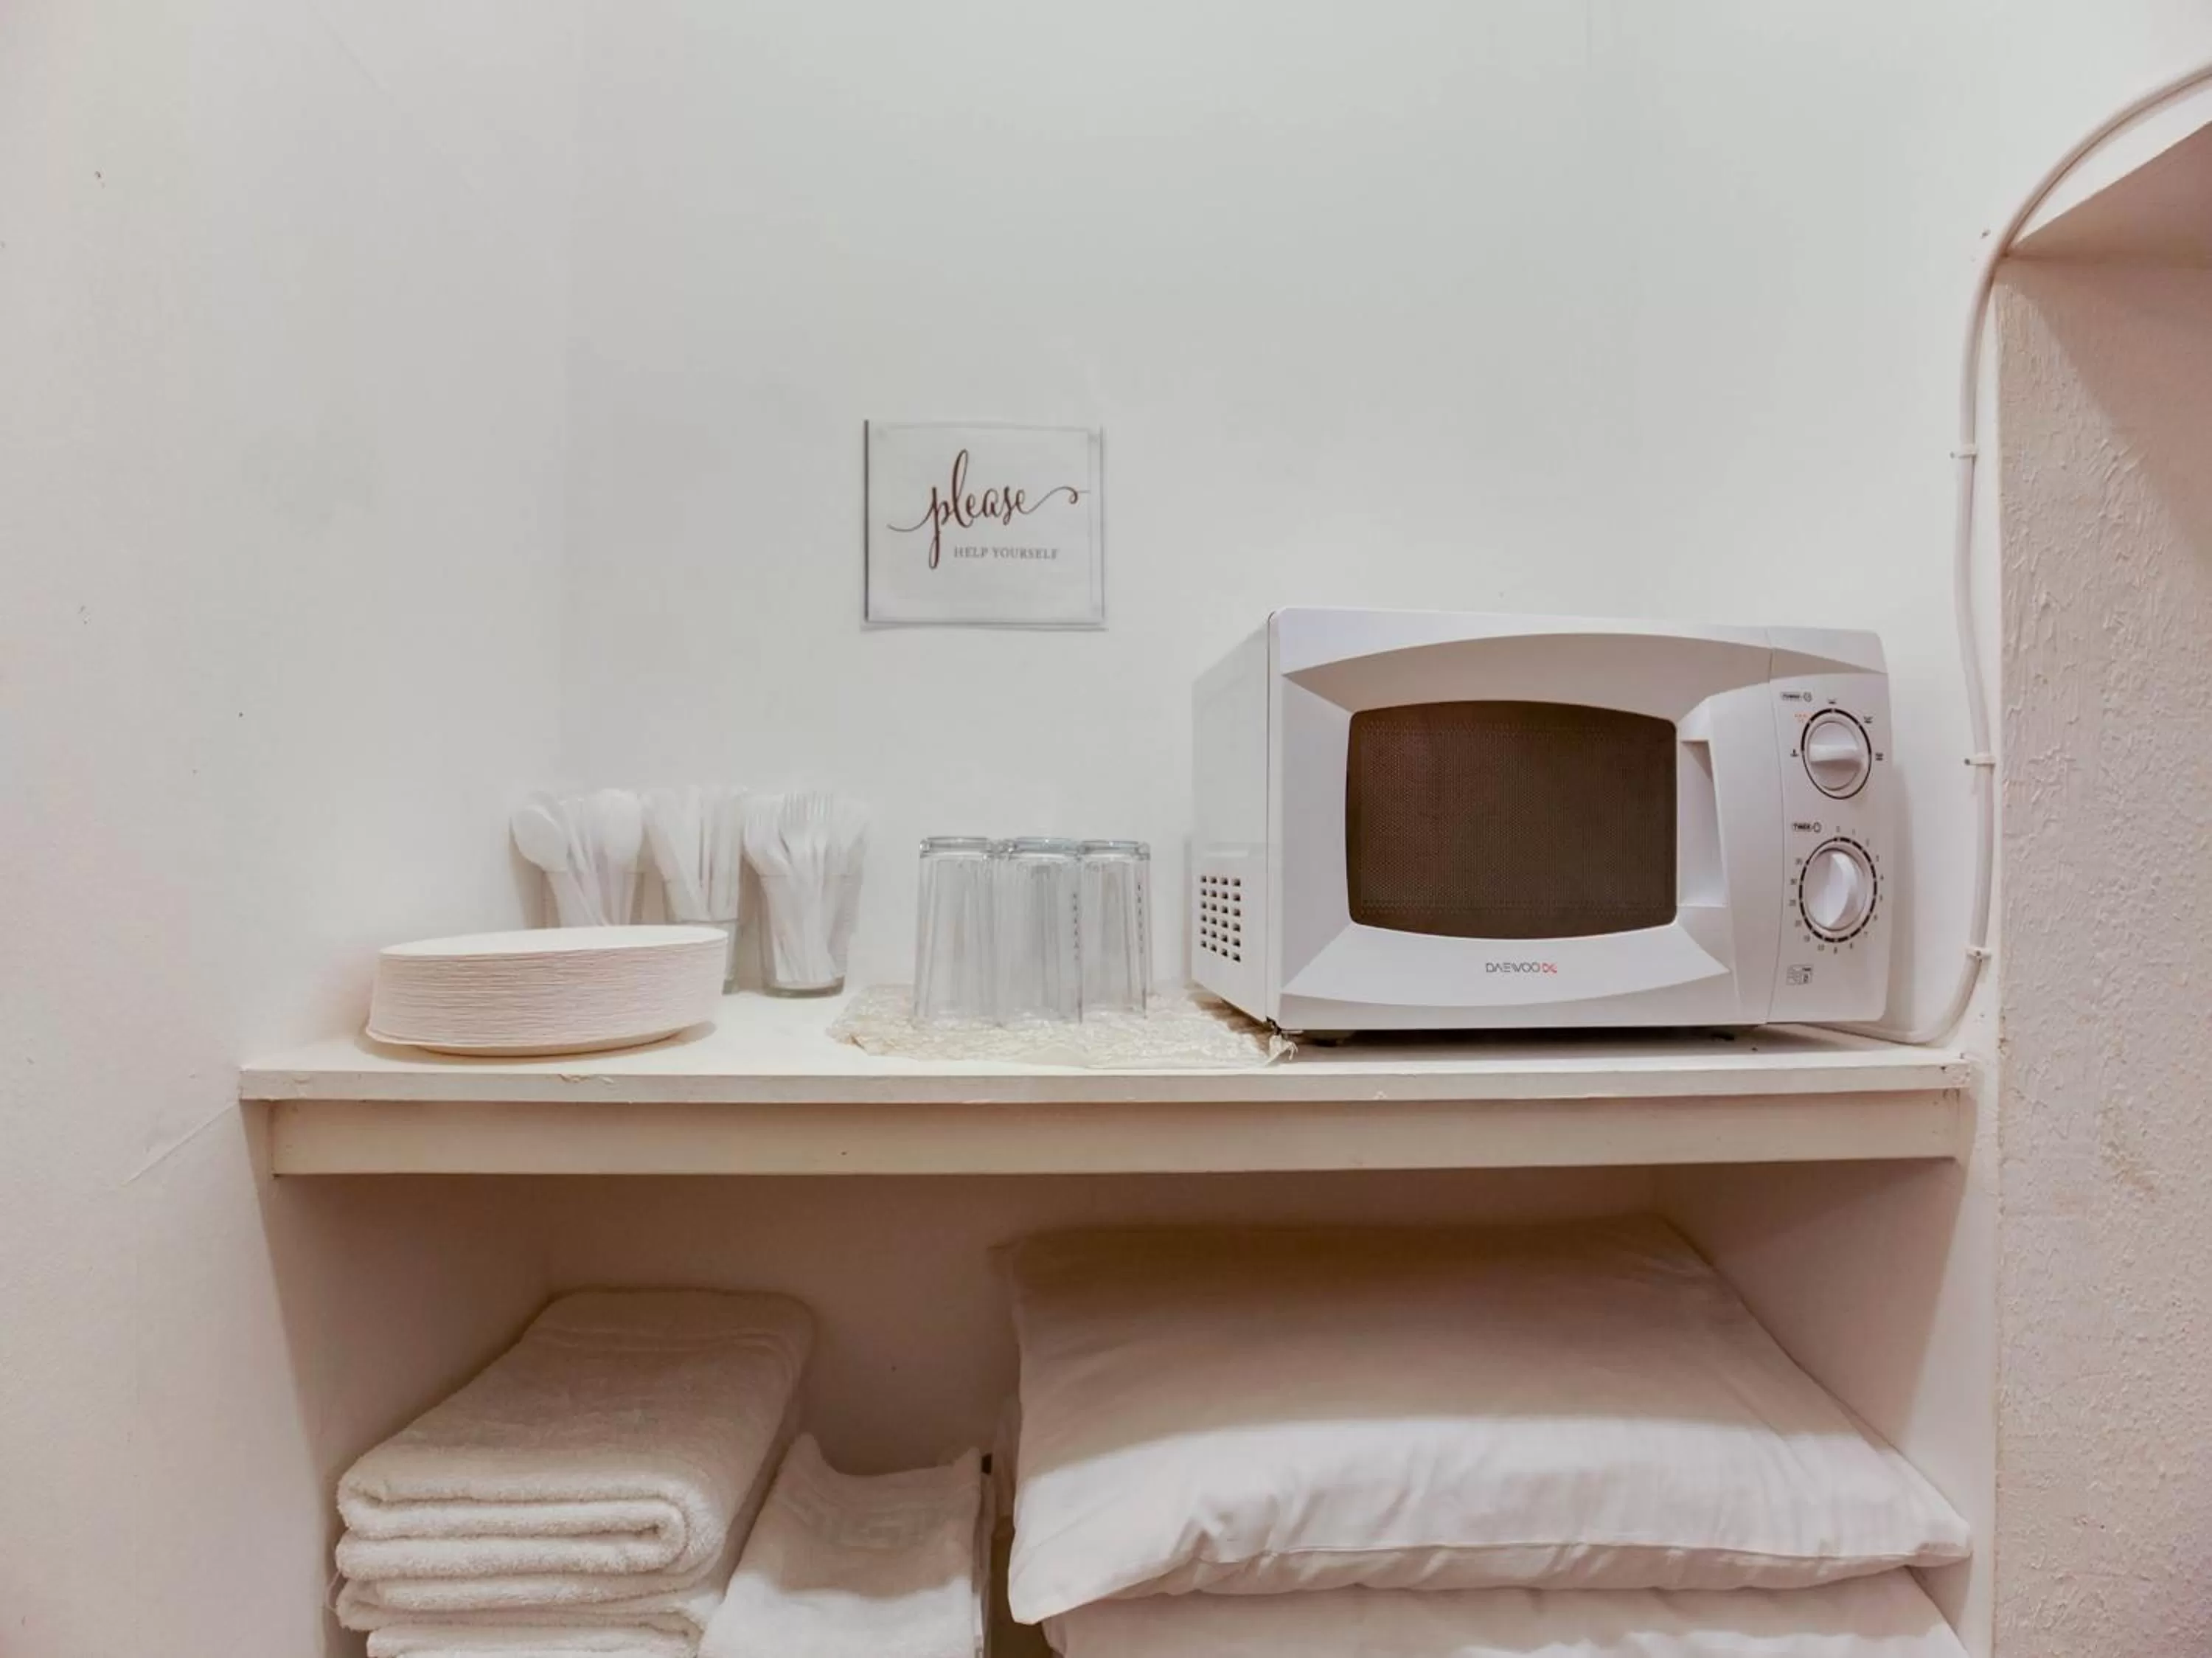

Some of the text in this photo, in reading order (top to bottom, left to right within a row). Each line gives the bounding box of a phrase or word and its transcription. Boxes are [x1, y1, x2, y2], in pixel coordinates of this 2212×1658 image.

[886, 448, 1079, 570] please
[953, 546, 1059, 561] HELP YOURSELF
[1485, 961, 1540, 973] DAEWOO
